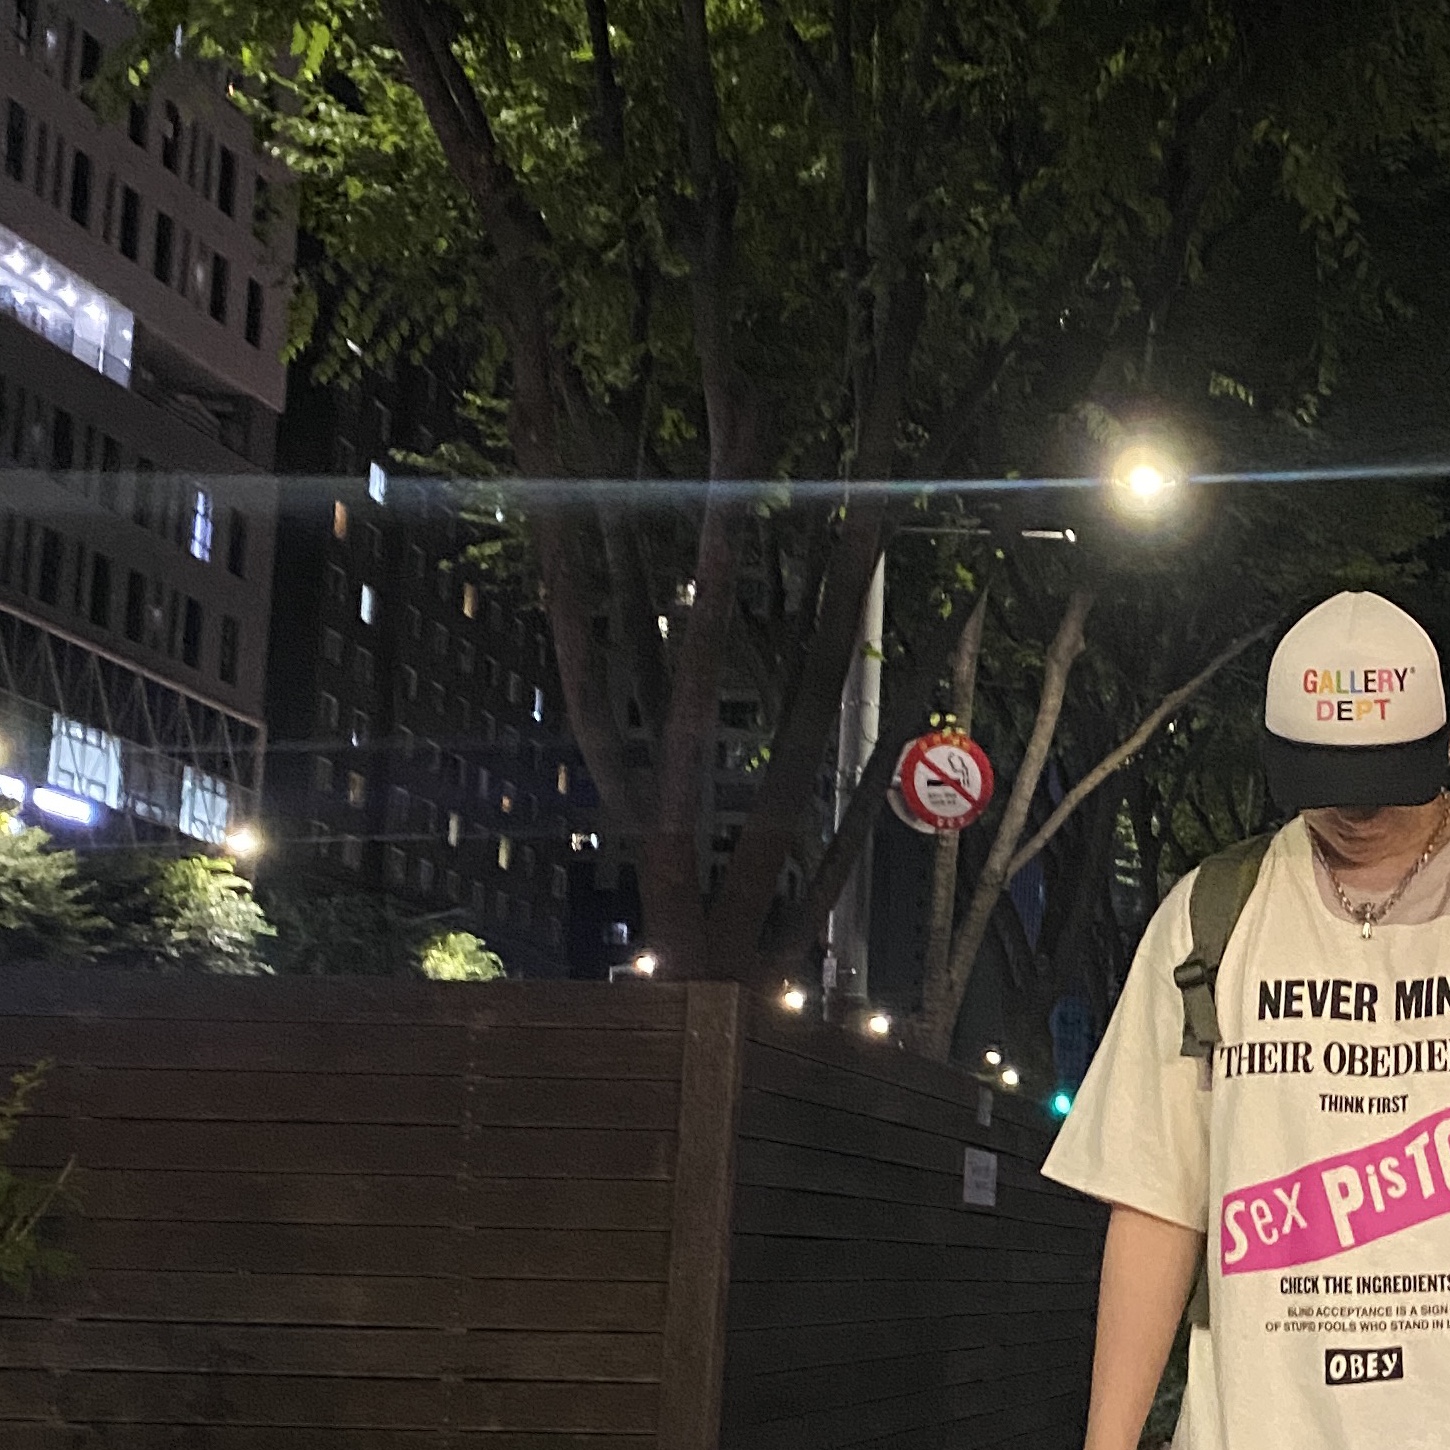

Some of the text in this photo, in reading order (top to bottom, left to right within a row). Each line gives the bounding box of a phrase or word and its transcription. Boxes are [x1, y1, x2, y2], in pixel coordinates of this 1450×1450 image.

[1303, 668, 1408, 694] GALLERY
[1317, 699, 1391, 721] DEPT
[1258, 979, 1378, 1023] NEVER
[1220, 1040, 1314, 1078] THEIR
[1319, 1093, 1409, 1114] THINK FIRST
[1280, 1275, 1319, 1295] CHECK
[1323, 1275, 1352, 1294] THE
[1316, 1305, 1393, 1317] ACCEPTANCE
[1395, 1305, 1407, 1316] IS
[1409, 1305, 1418, 1315] A
[1420, 1303, 1449, 1316] SIGN
[1265, 1321, 1281, 1332] OF
[1318, 1321, 1357, 1332] FOOLS
[1359, 1320, 1387, 1331] WHO
[1390, 1319, 1429, 1331] STAND
[1432, 1319, 1444, 1330] IN
[1329, 1352, 1398, 1381] OBEY
